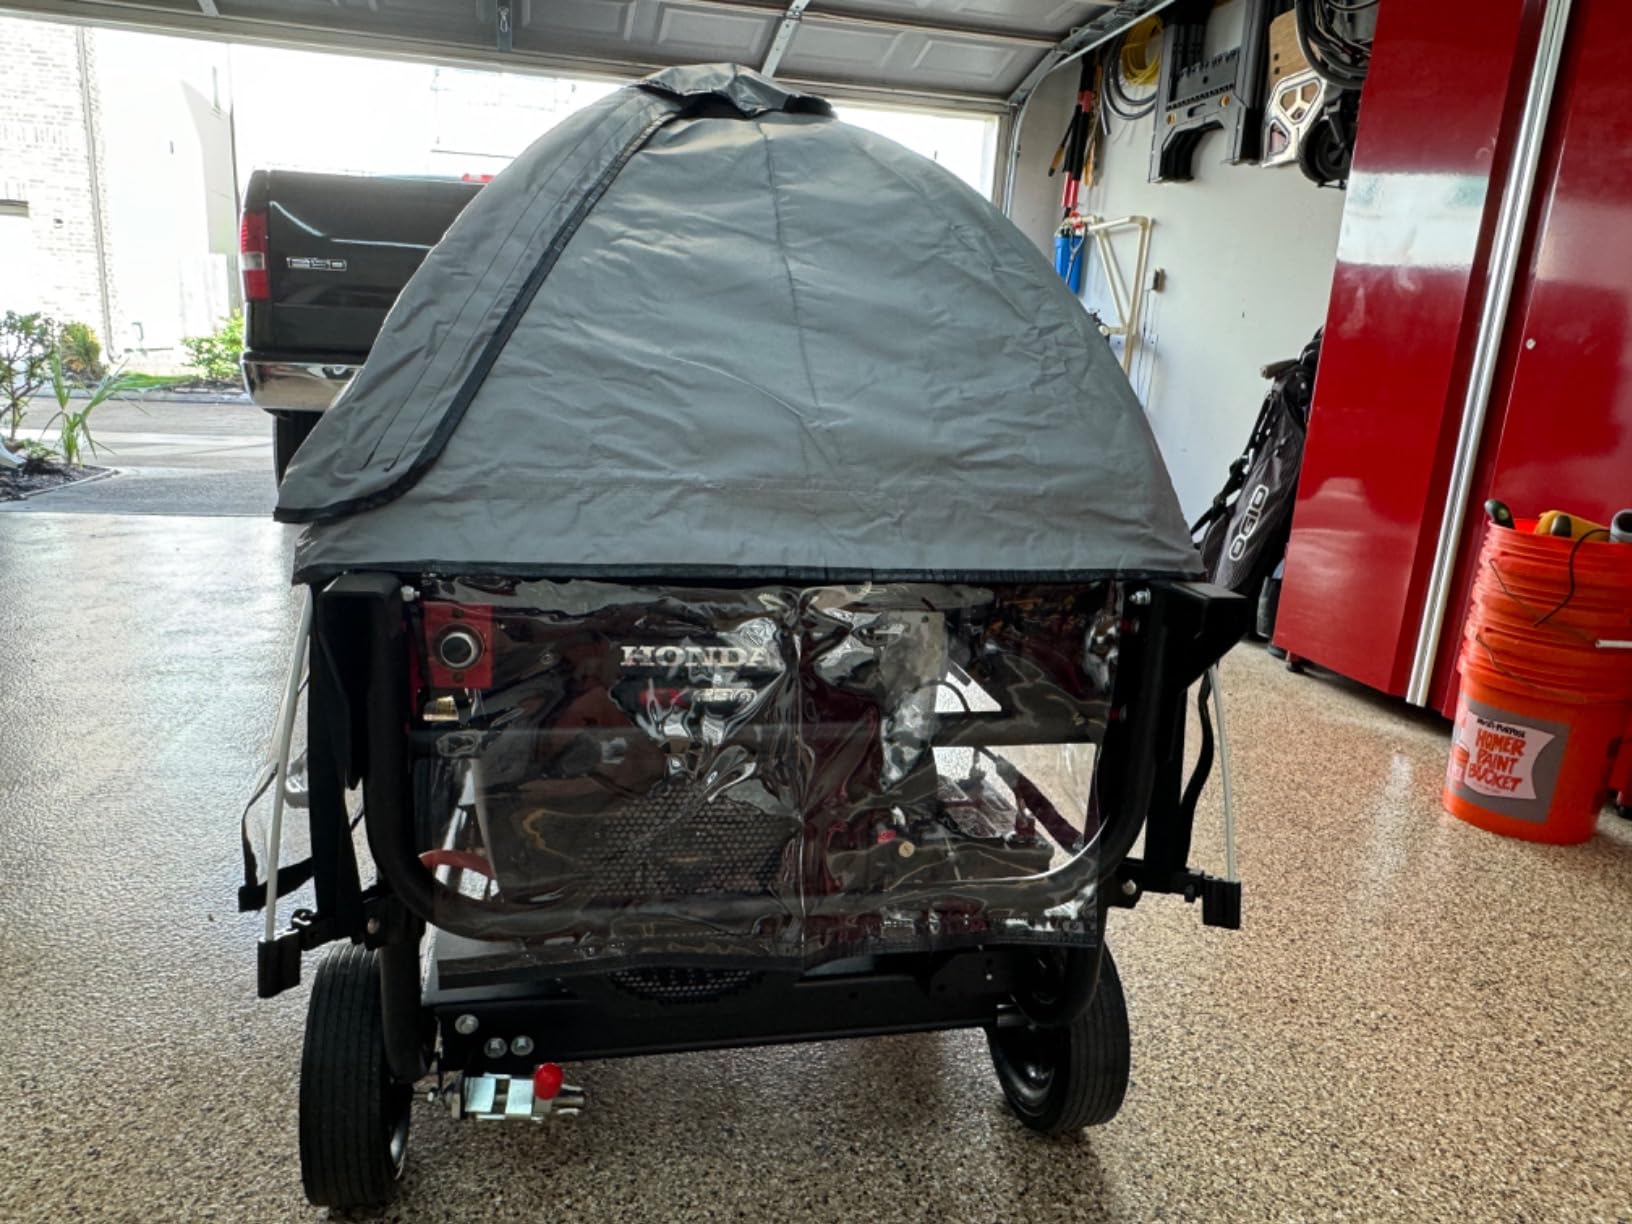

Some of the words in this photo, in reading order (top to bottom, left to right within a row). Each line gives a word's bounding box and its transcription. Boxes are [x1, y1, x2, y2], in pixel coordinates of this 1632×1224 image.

[1229, 484, 1269, 561] OGIO
[620, 646, 775, 667] HONDA
[1476, 728, 1526, 757] HOMER
[1477, 748, 1518, 774] PAINT
[1468, 762, 1523, 792] BUCKET
